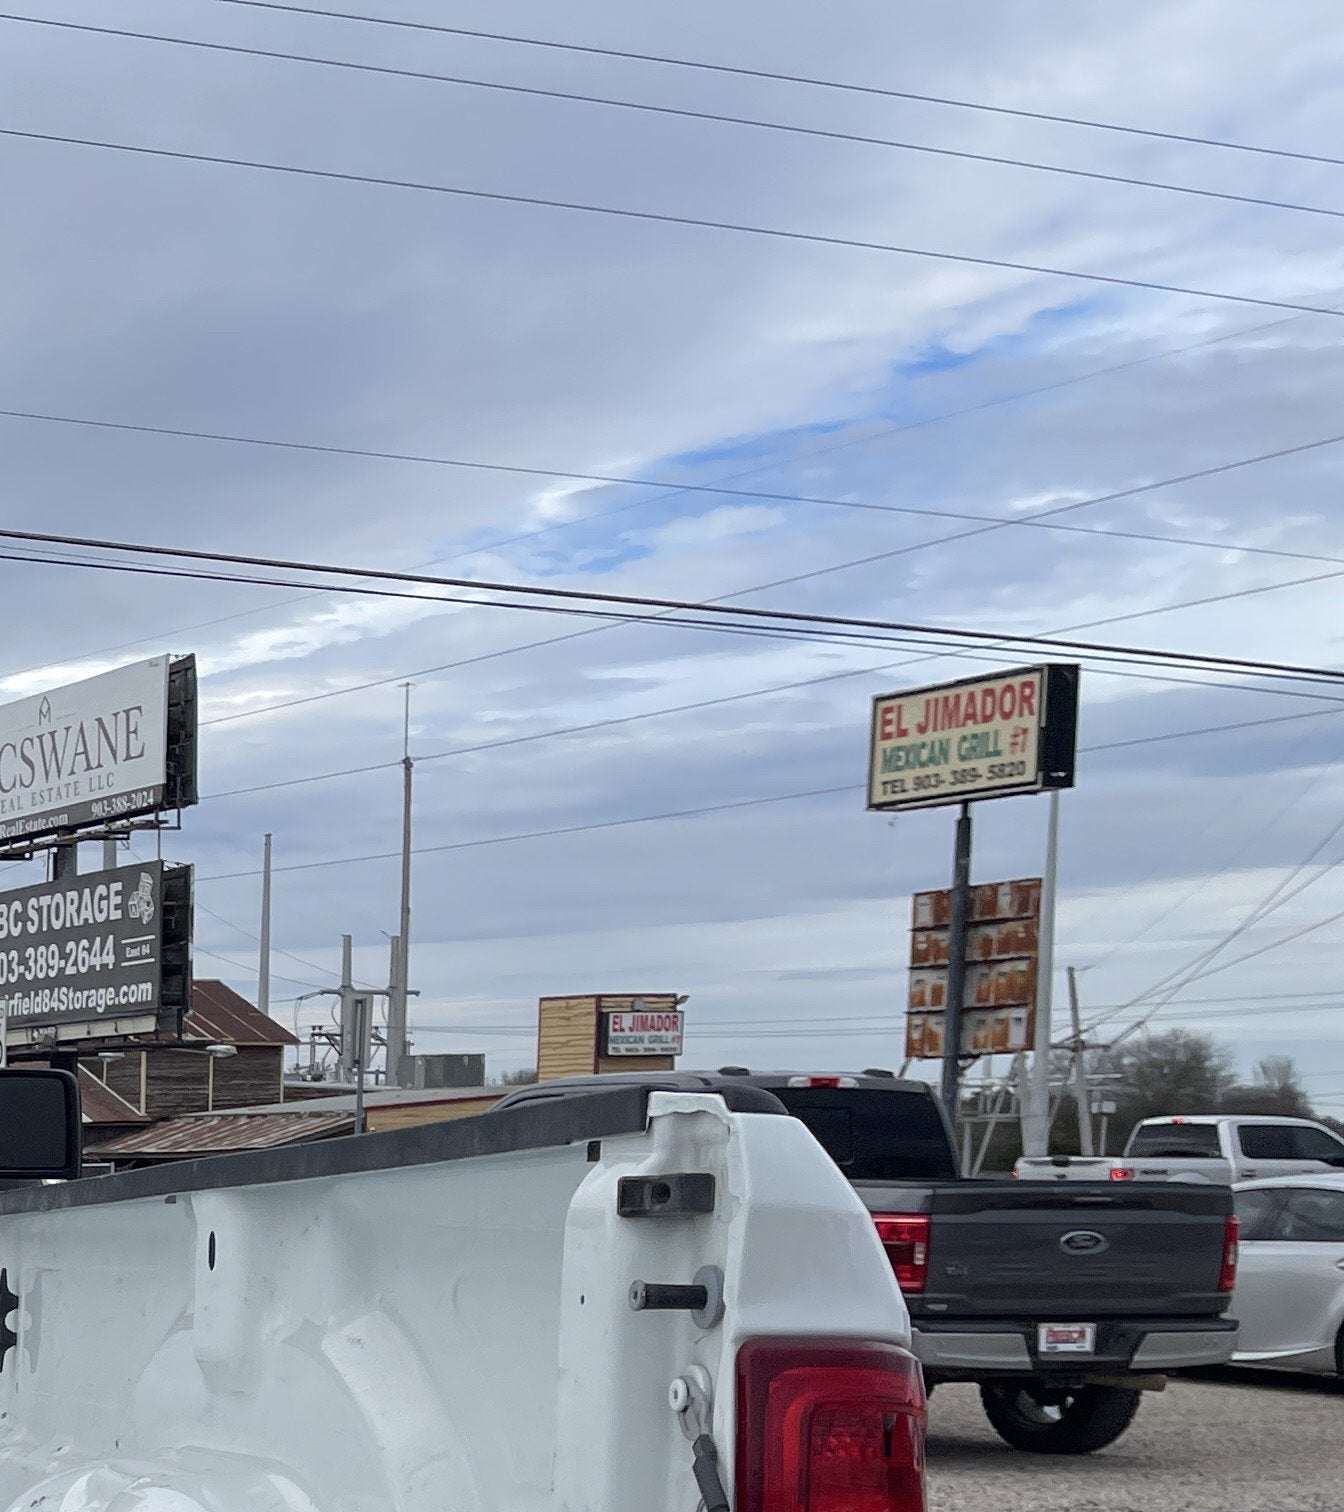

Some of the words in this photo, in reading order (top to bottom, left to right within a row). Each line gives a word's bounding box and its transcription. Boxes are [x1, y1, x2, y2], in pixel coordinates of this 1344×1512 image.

[879, 703, 909, 742] EL
[916, 681, 1036, 735] JIMADOR
[881, 737, 952, 774] MEXICAN
[957, 729, 1003, 764] GRILL
[31, 780, 81, 807] ESTATE
[88, 771, 115, 793] LLC
[881, 778, 909, 796] TEL
[26, 881, 123, 935] STORAGE
[612, 1014, 625, 1033] EL
[628, 1014, 679, 1033] JIMADOR
